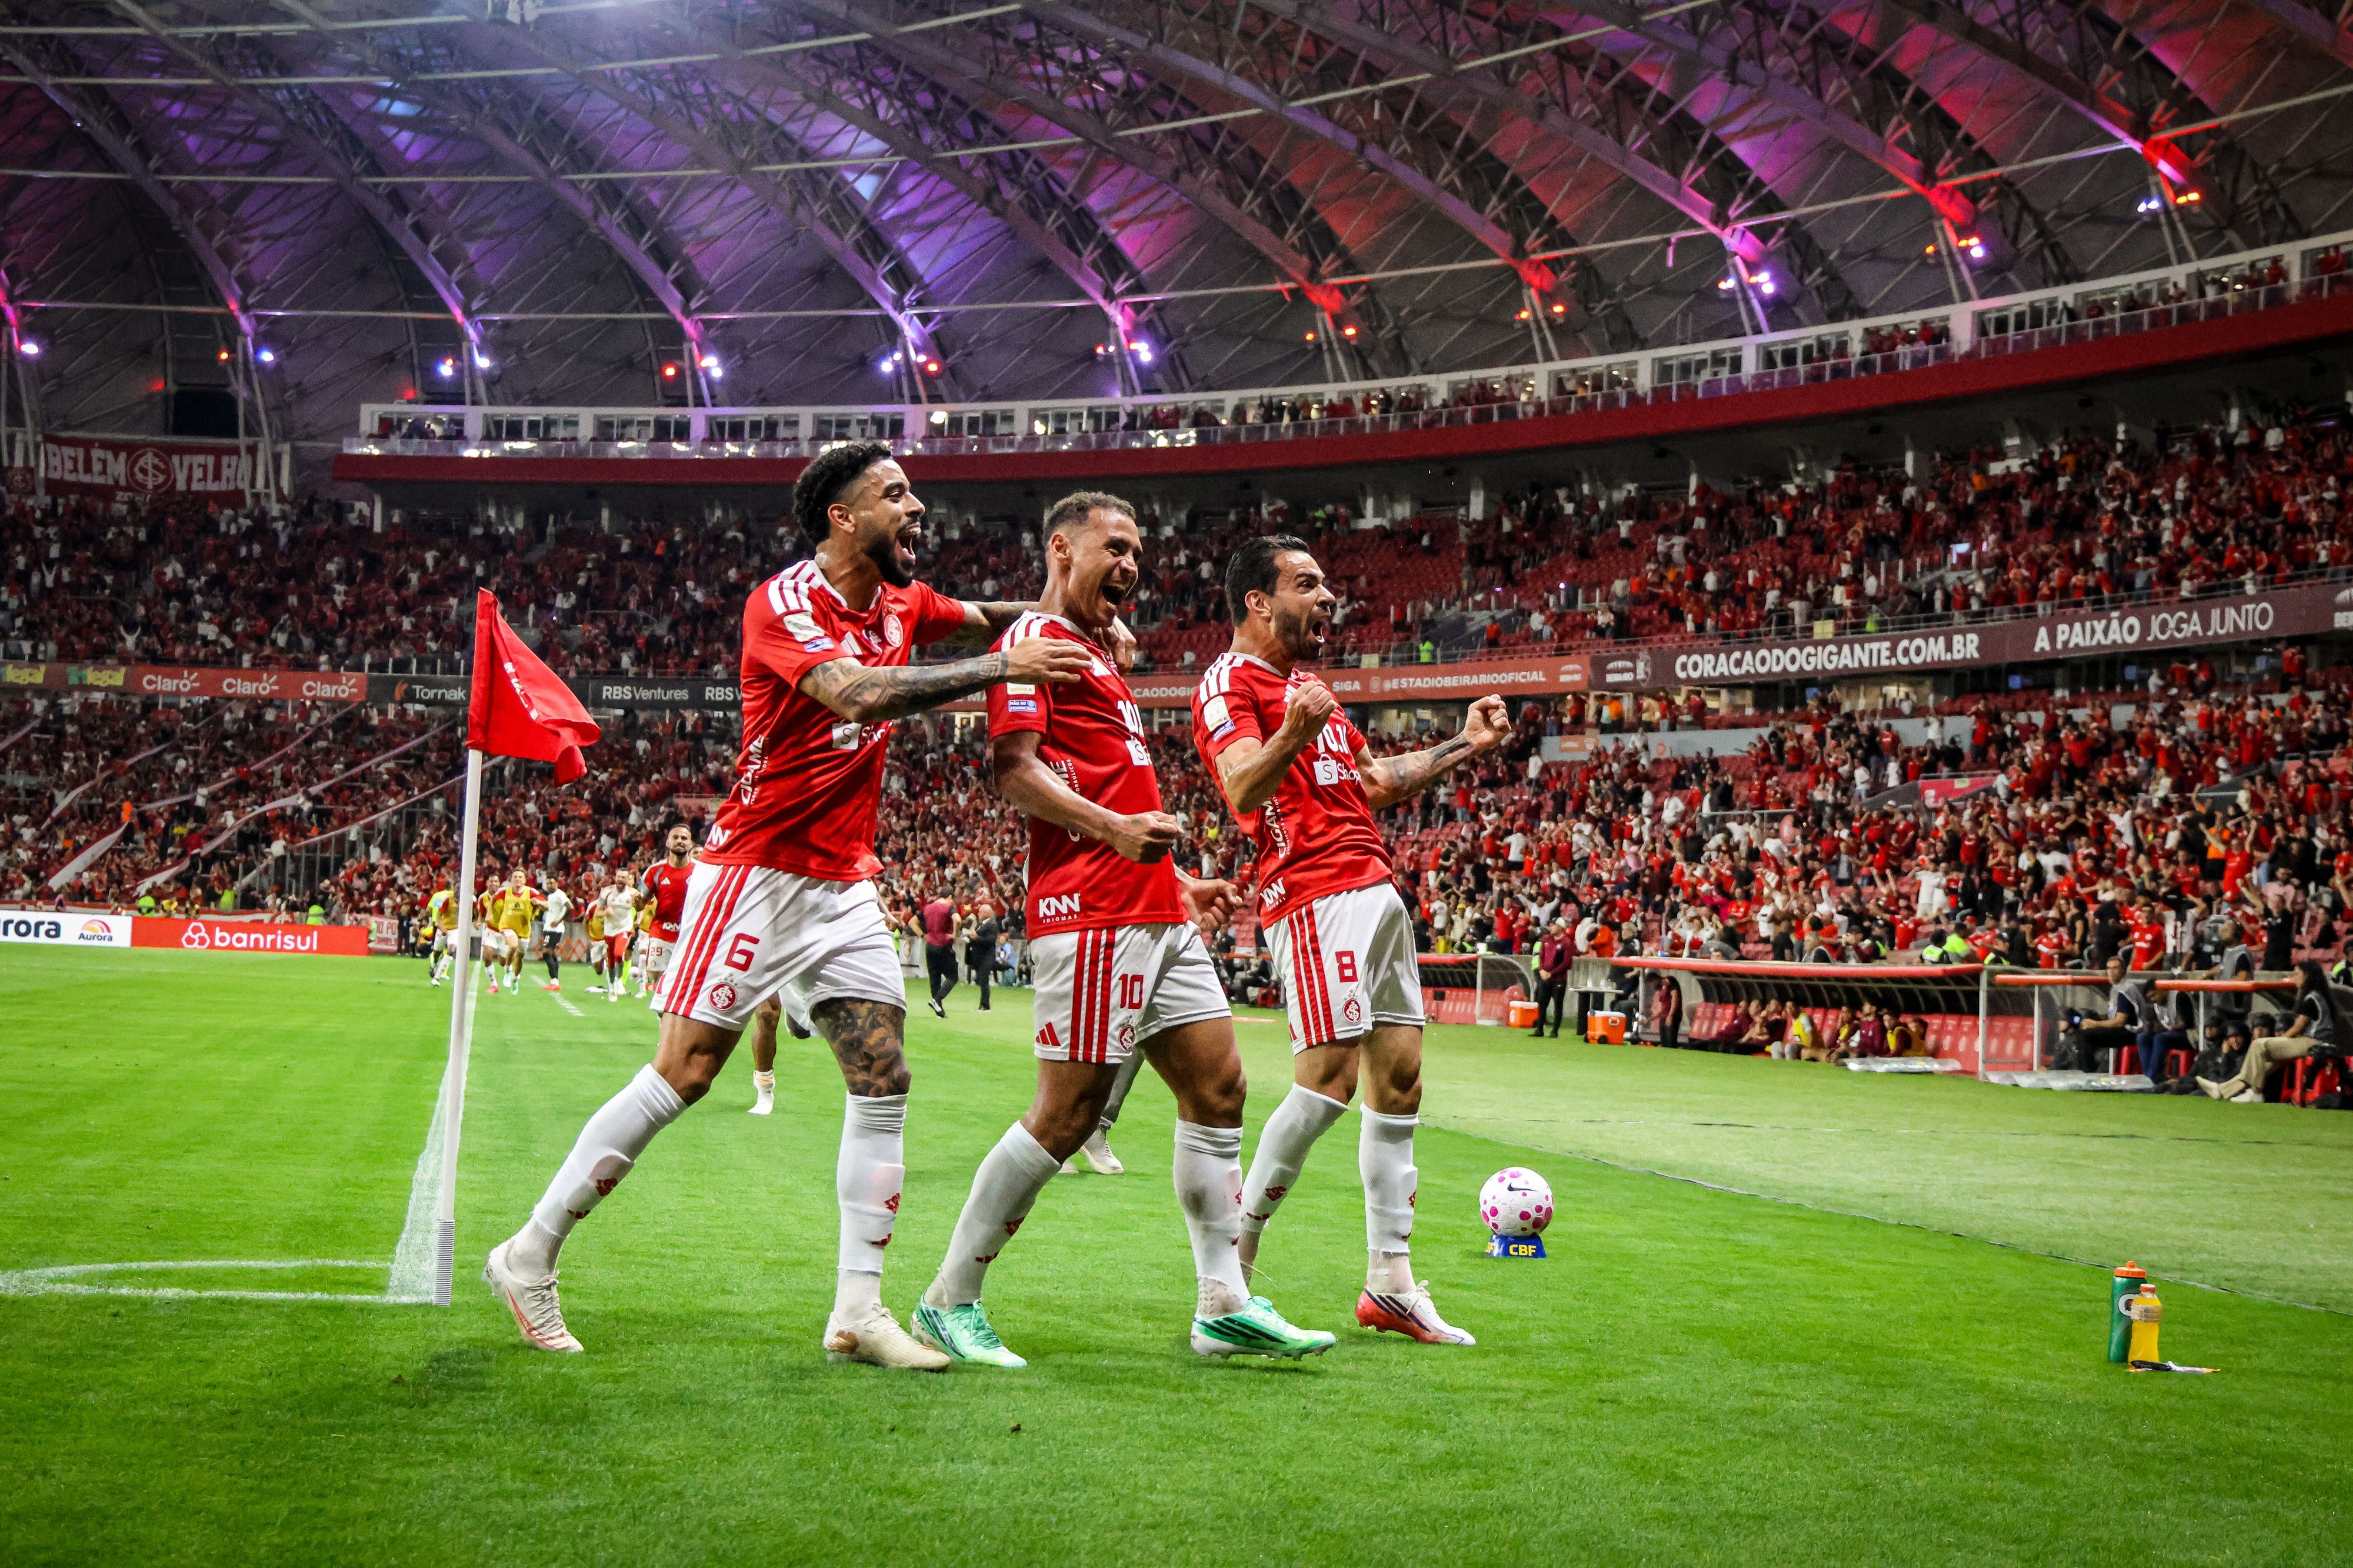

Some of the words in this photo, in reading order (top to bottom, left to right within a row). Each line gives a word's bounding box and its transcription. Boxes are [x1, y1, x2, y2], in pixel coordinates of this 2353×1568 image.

[46, 442, 126, 487] BELÉM
[2034, 626, 2051, 653] A
[2056, 611, 2141, 650] PAIXÃO
[2147, 611, 2203, 642] JOGA
[2207, 602, 2274, 636] JUNTO
[1675, 633, 1979, 679] CORACAODOGIGANTE.COM.BR
[142, 674, 191, 692] Claro
[223, 678, 270, 695] Claro
[302, 680, 350, 699] Claro
[412, 685, 466, 700] Tornak
[1332, 681, 1361, 692] SIGA
[1262, 798, 1287, 859] CIGAM
[1039, 893, 1081, 918] KNN
[1043, 914, 1078, 923] IDIOMAS
[0, 919, 61, 938] rora
[78, 933, 113, 942] Aurora
[215, 926, 317, 950] banrisul
[651, 946, 663, 956] 29
[725, 932, 760, 972] 6
[1335, 950, 1358, 983] 8
[1118, 973, 1144, 1009] 10
[1509, 1244, 1537, 1256] CBF
